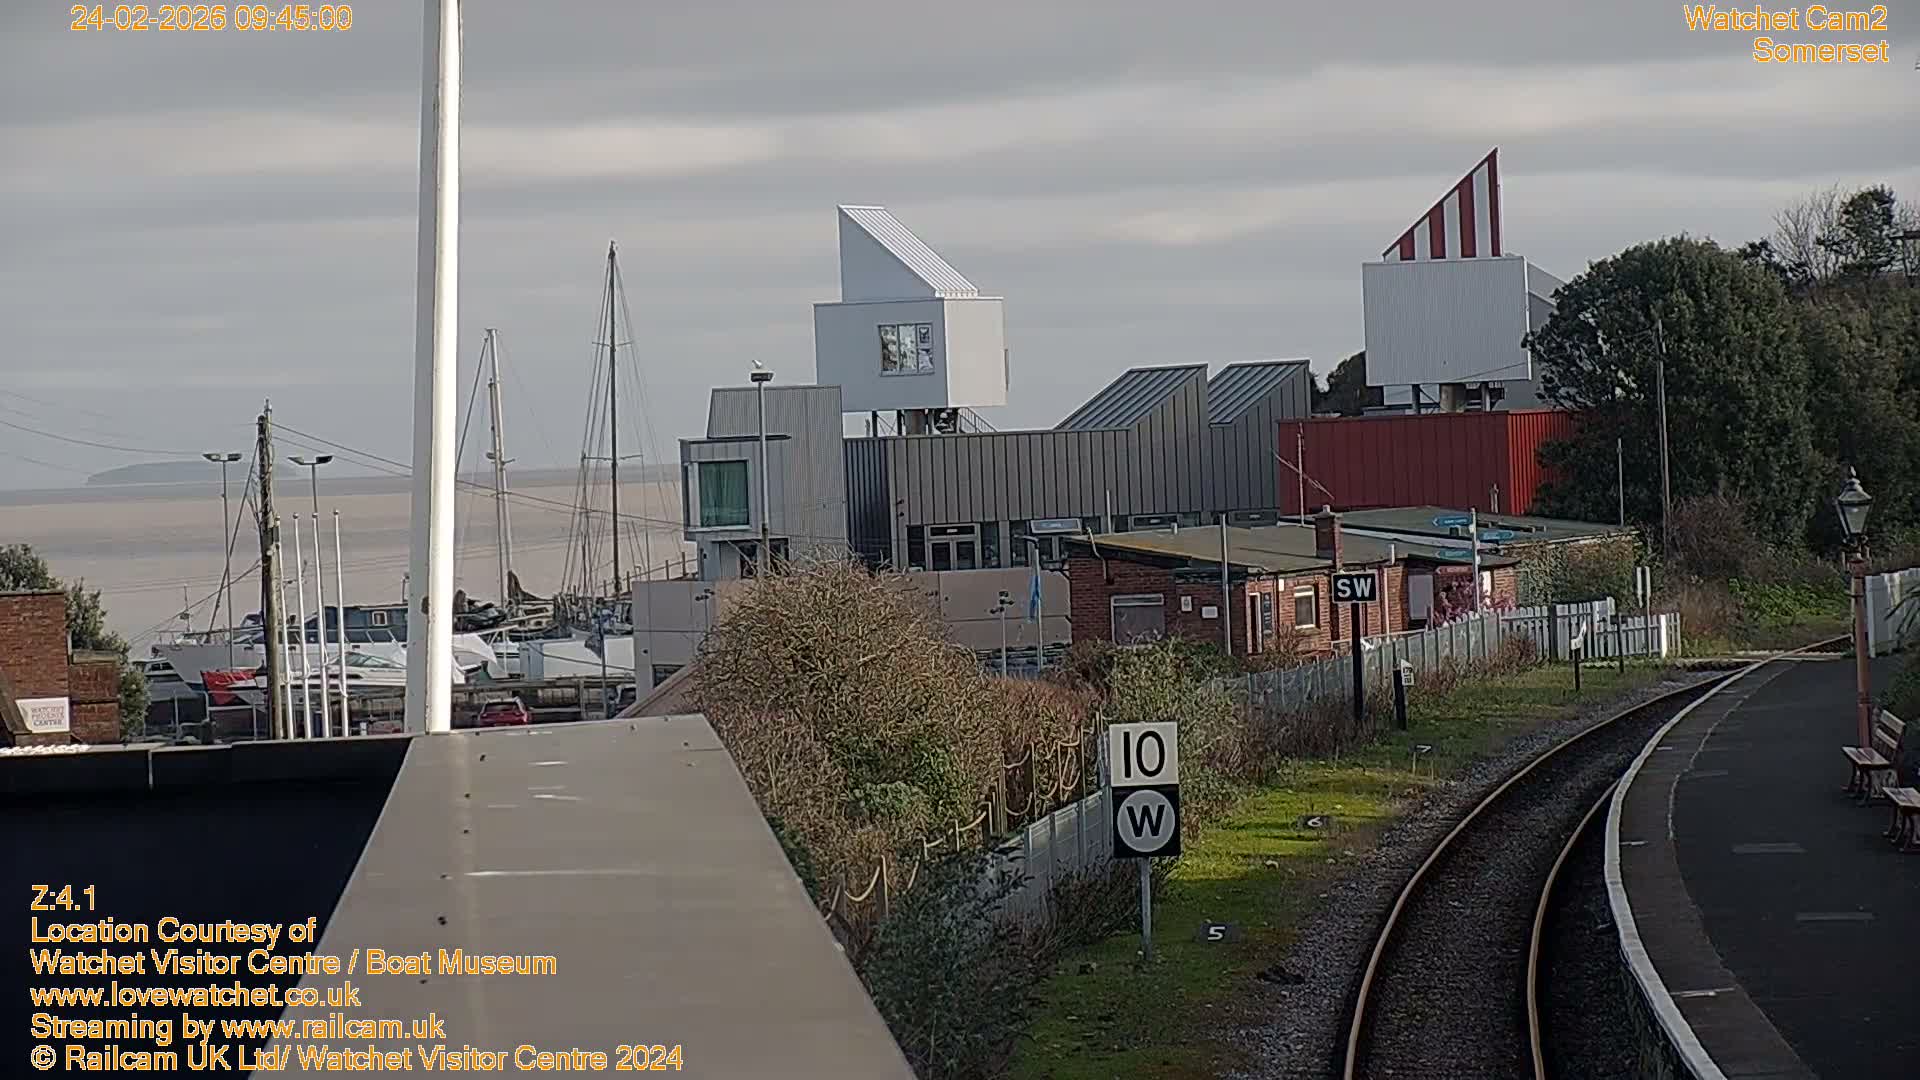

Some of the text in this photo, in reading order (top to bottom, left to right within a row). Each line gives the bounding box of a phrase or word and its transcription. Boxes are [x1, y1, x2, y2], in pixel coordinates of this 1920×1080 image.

[1336, 577, 1372, 598] SW
[1123, 730, 1166, 779] 10
[1126, 804, 1166, 838] W
[1307, 816, 1323, 828] 6
[1207, 926, 1226, 941] 5
